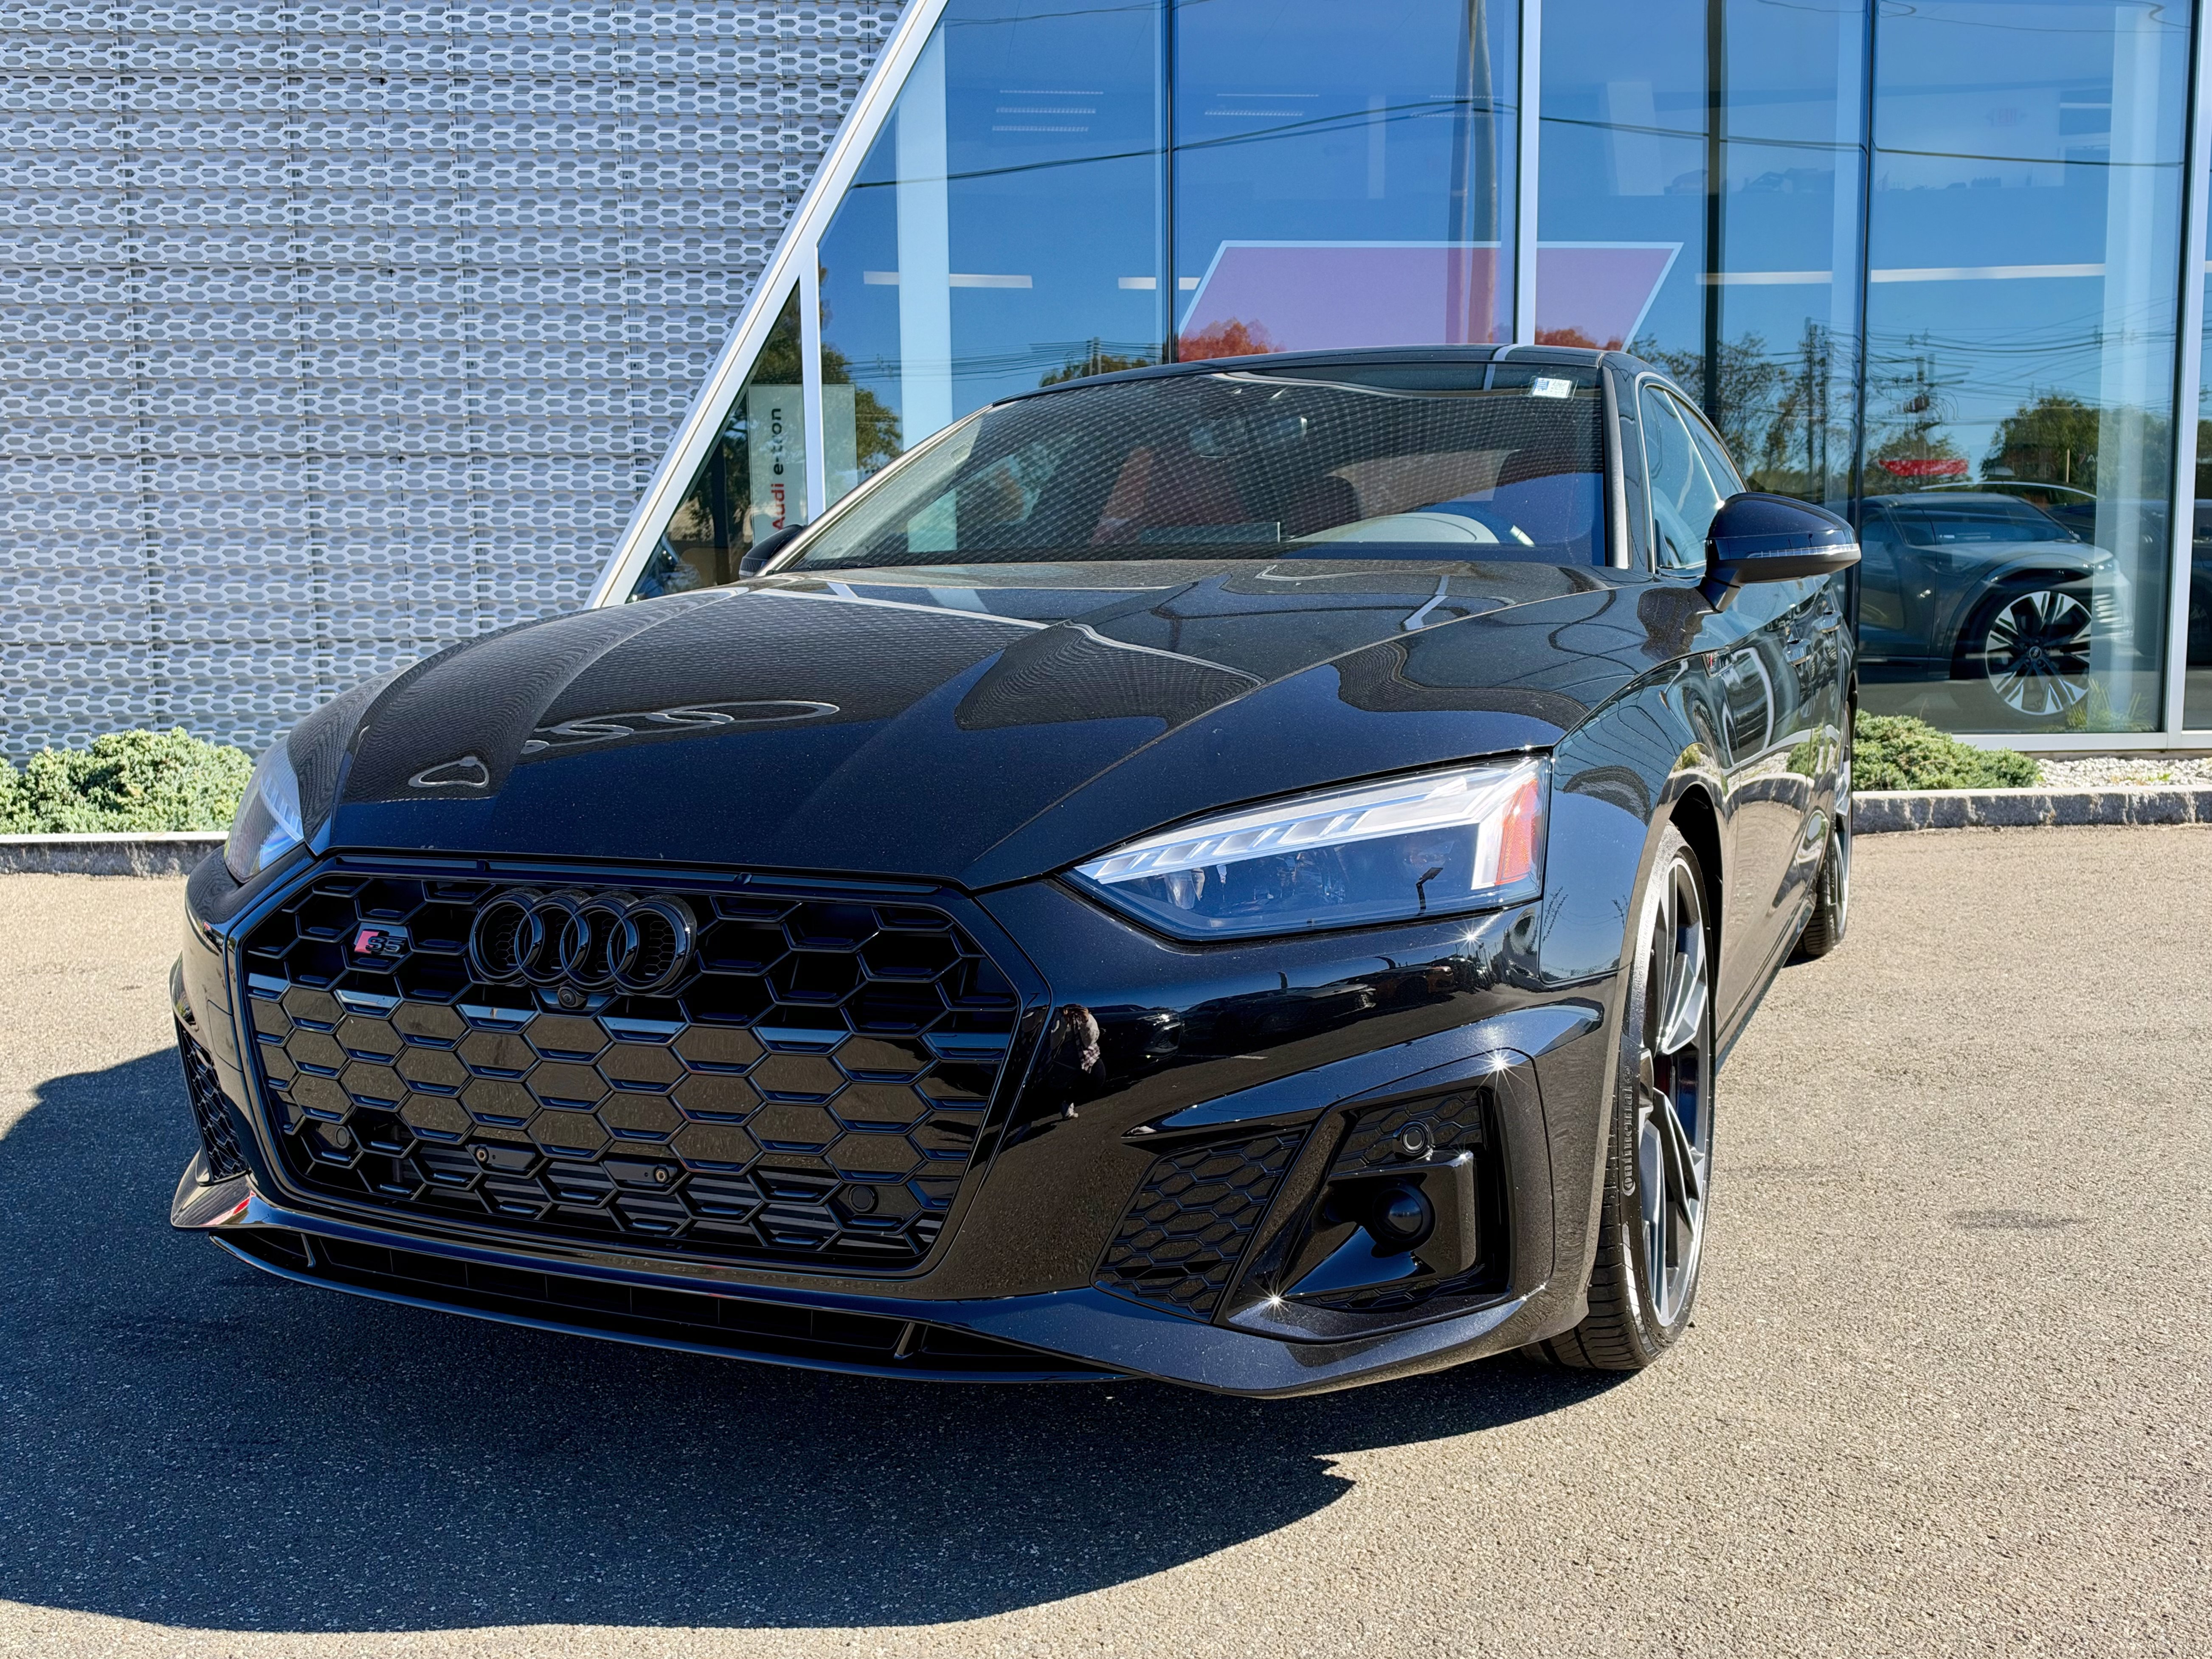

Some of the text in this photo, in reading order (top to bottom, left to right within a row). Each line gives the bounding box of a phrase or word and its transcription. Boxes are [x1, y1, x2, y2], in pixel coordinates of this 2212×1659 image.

[771, 408, 785, 530] Audi e-tron
[364, 935, 406, 953] S5
[1622, 1086, 1635, 1196] Continental
